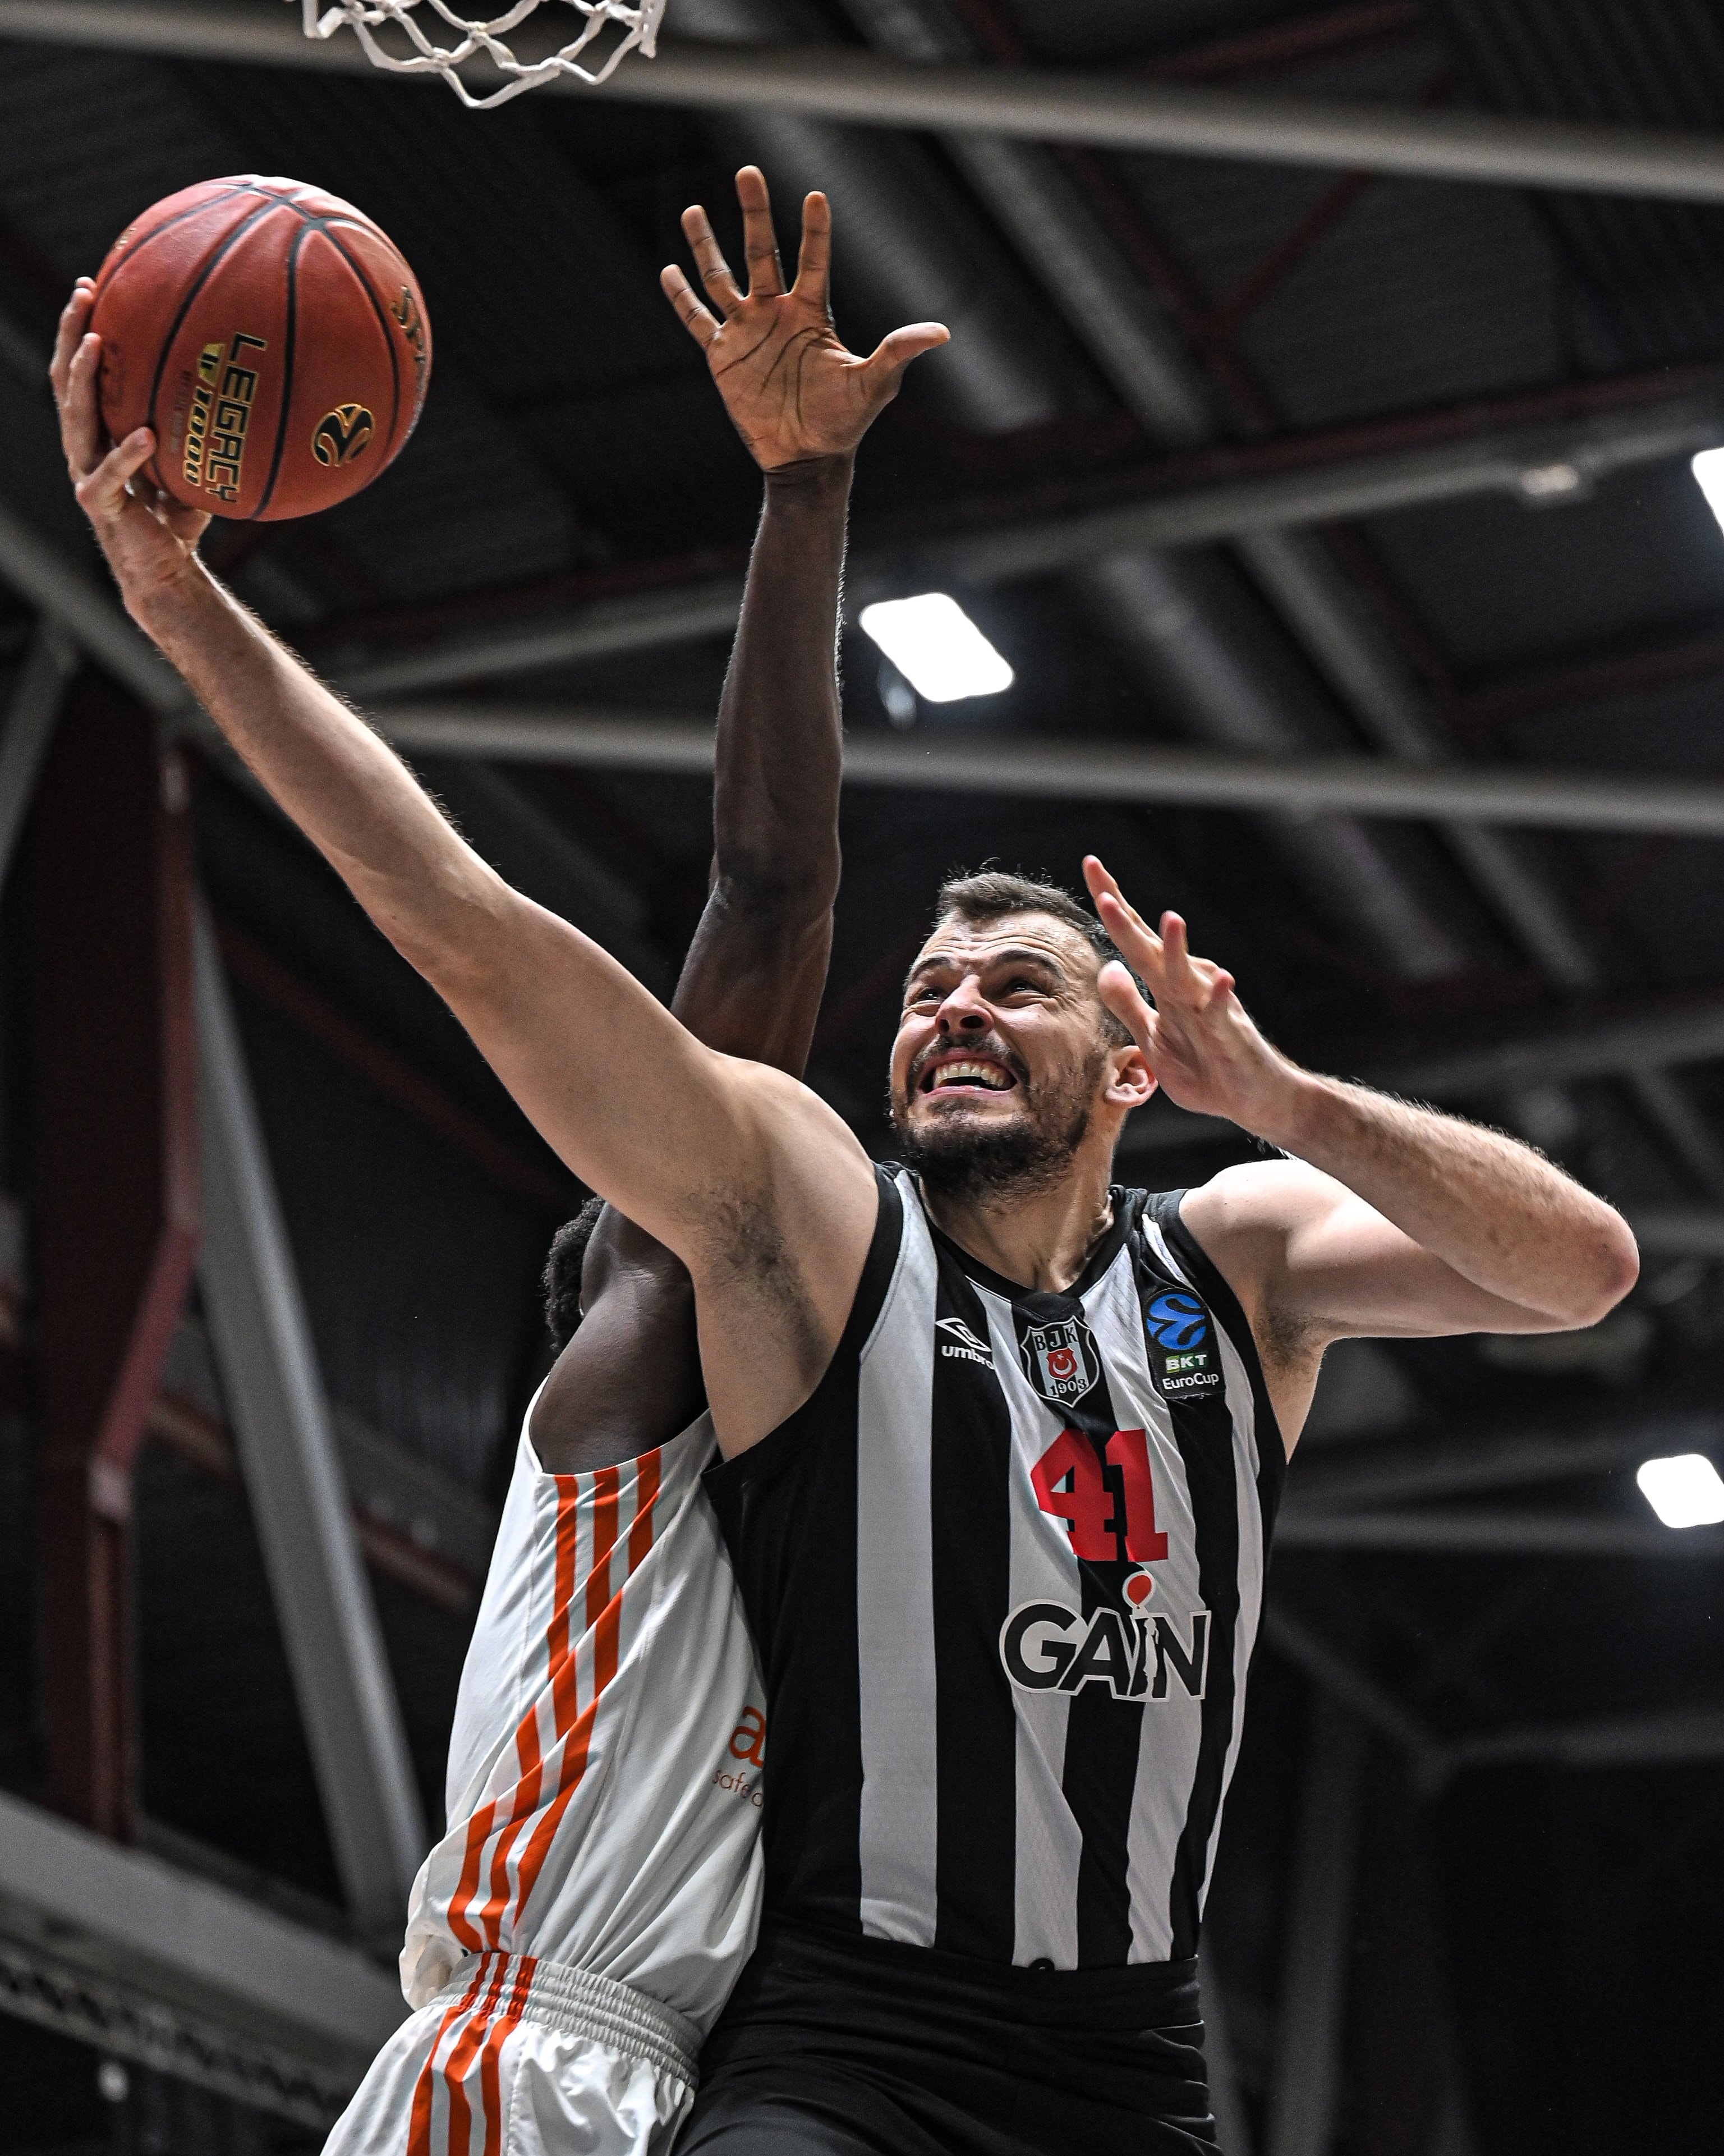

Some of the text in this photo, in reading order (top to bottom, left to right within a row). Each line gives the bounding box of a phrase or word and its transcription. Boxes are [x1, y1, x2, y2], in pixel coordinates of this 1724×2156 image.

[205, 332, 268, 503] LEGACY
[1033, 1327, 1078, 1351] BJK
[941, 1345, 996, 1370] umbro
[1166, 1354, 1207, 1371] BKT
[1049, 1378, 1088, 1396] 1903
[1162, 1373, 1220, 1390] EuroCup
[1031, 1428, 1169, 1563] 41
